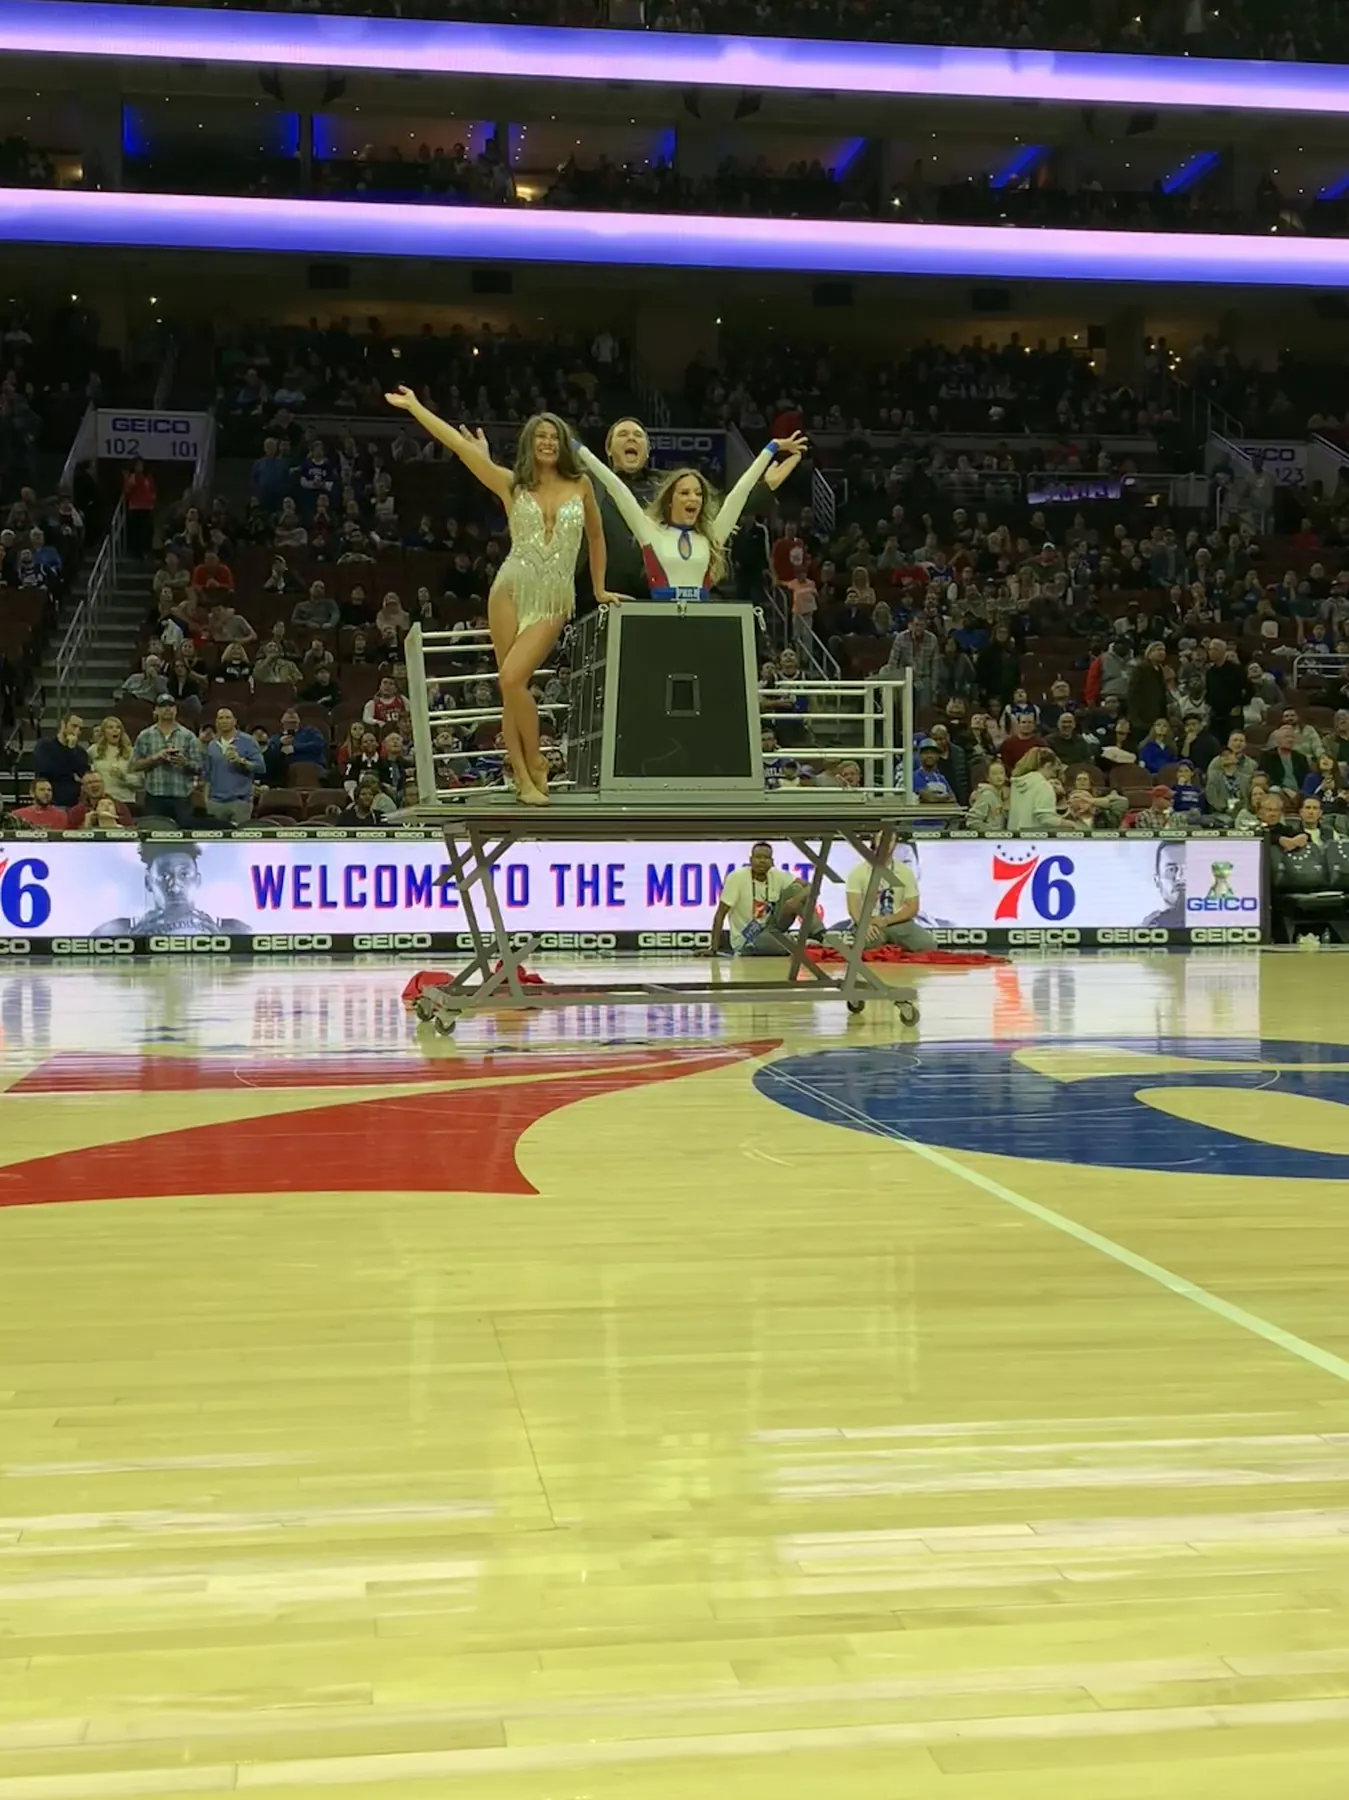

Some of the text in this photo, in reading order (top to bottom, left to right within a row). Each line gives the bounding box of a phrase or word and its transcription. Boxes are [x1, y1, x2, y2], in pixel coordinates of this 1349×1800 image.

[112, 417, 190, 434] GEICO
[104, 437, 198, 457] 102 101
[250, 864, 461, 910] WELCOME
[549, 863, 625, 908] THE
[993, 855, 1076, 921] 76
[1187, 897, 1257, 911] GEICO
[252, 935, 332, 951] GEICO
[353, 933, 432, 950] GEICO
[540, 933, 617, 949] GEICO
[638, 932, 713, 948] GEICO
[929, 928, 987, 944] EICO
[1008, 928, 1081, 944] GEICO
[1097, 928, 1169, 943] GEICO
[1190, 928, 1262, 943] GEICO
[51, 939, 135, 954] GEICO
[150, 936, 231, 952] GEICO
